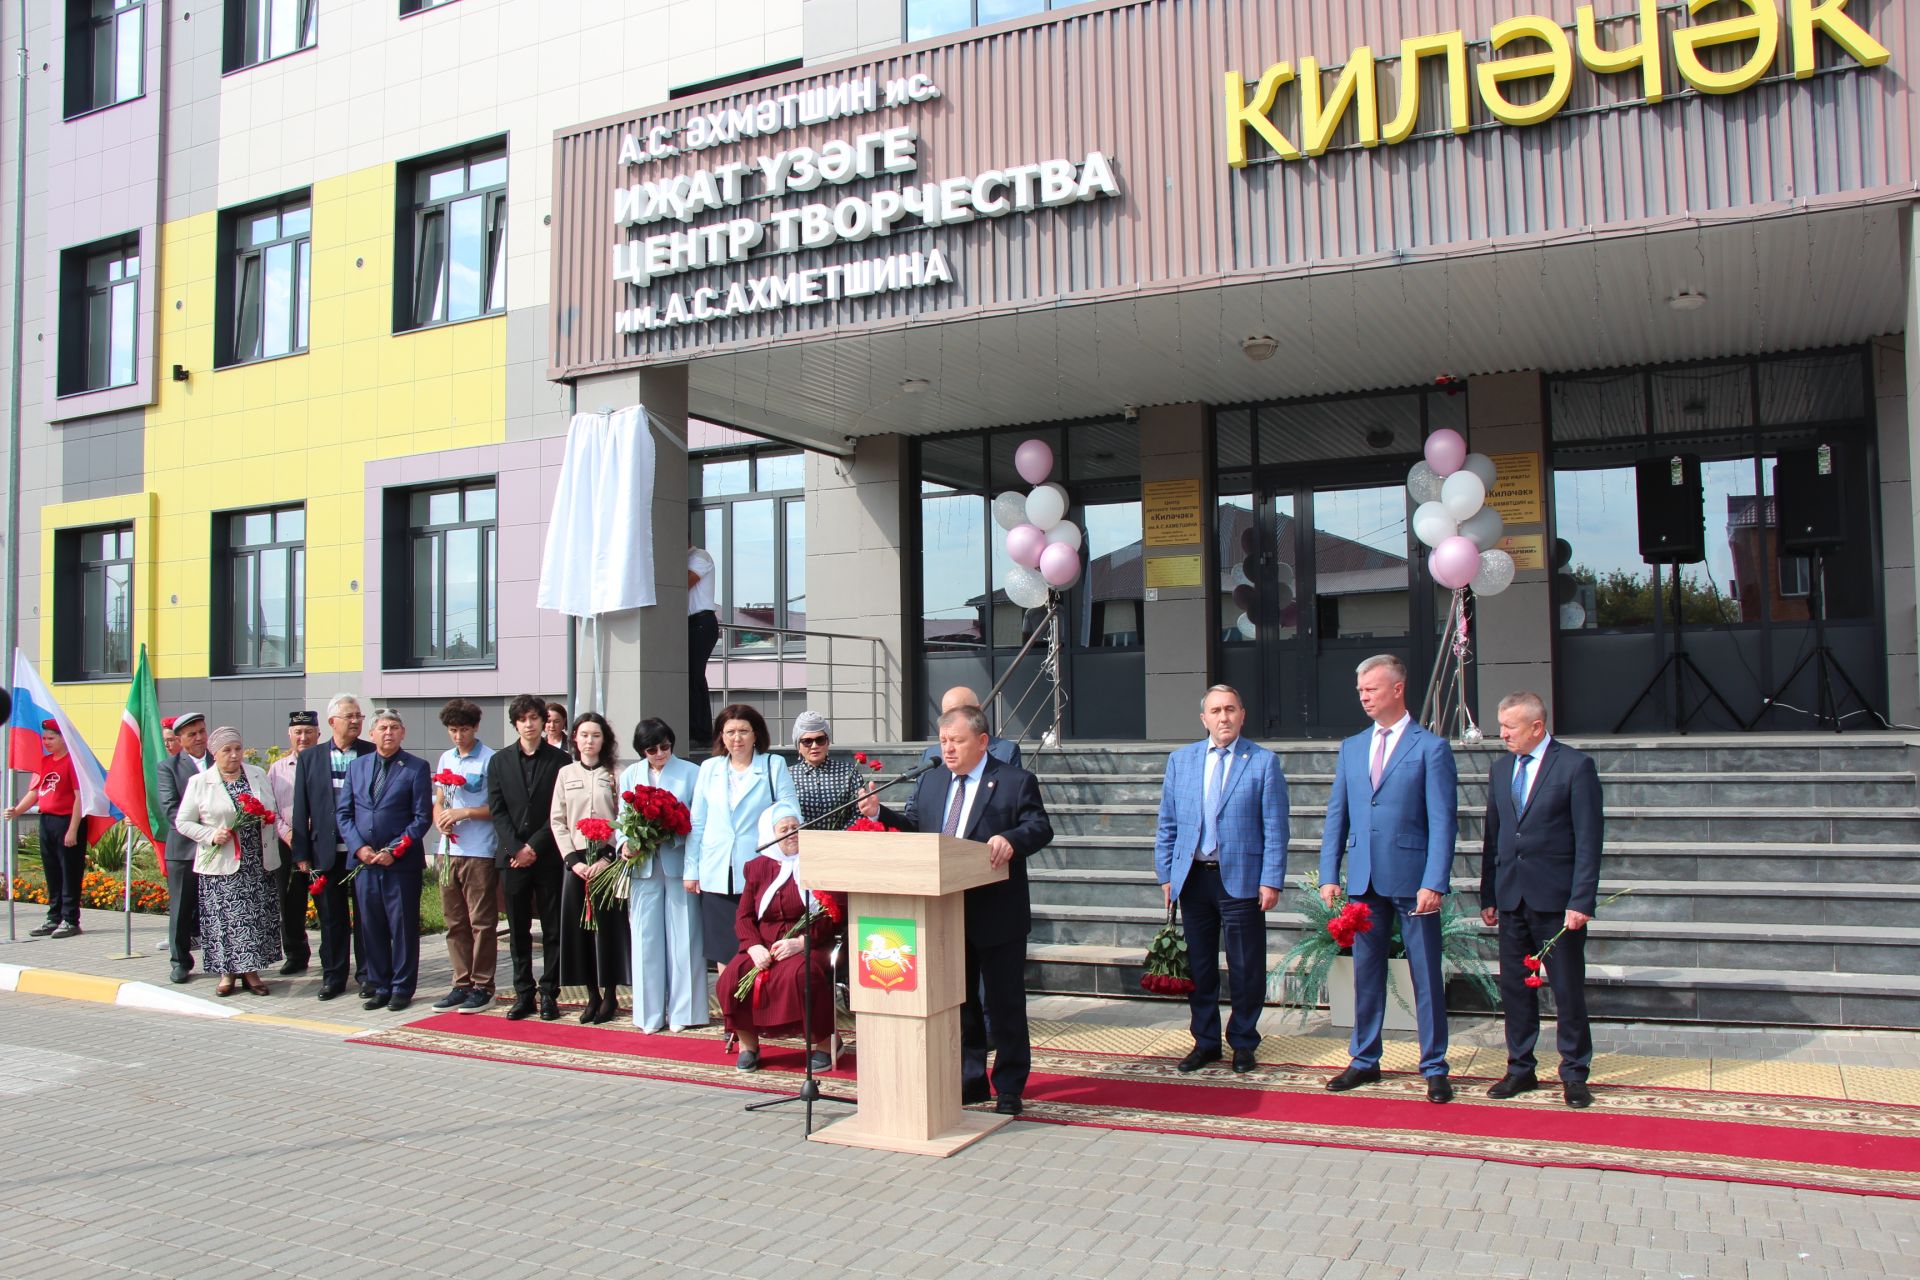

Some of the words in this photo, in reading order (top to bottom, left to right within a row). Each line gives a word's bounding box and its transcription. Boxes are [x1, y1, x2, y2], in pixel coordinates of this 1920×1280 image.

[618, 126, 680, 165] А.С.
[686, 76, 877, 150] ӘХМӘТШИН
[886, 73, 940, 108] ис.
[1225, 0, 1890, 168] КИЛӘЧӘК
[613, 218, 764, 286] ЦЕНТР
[770, 151, 1121, 252] ТВОРЧЕСТВА
[614, 163, 753, 227] ИҖАТ
[757, 125, 917, 197] ҮЗӘГЕ
